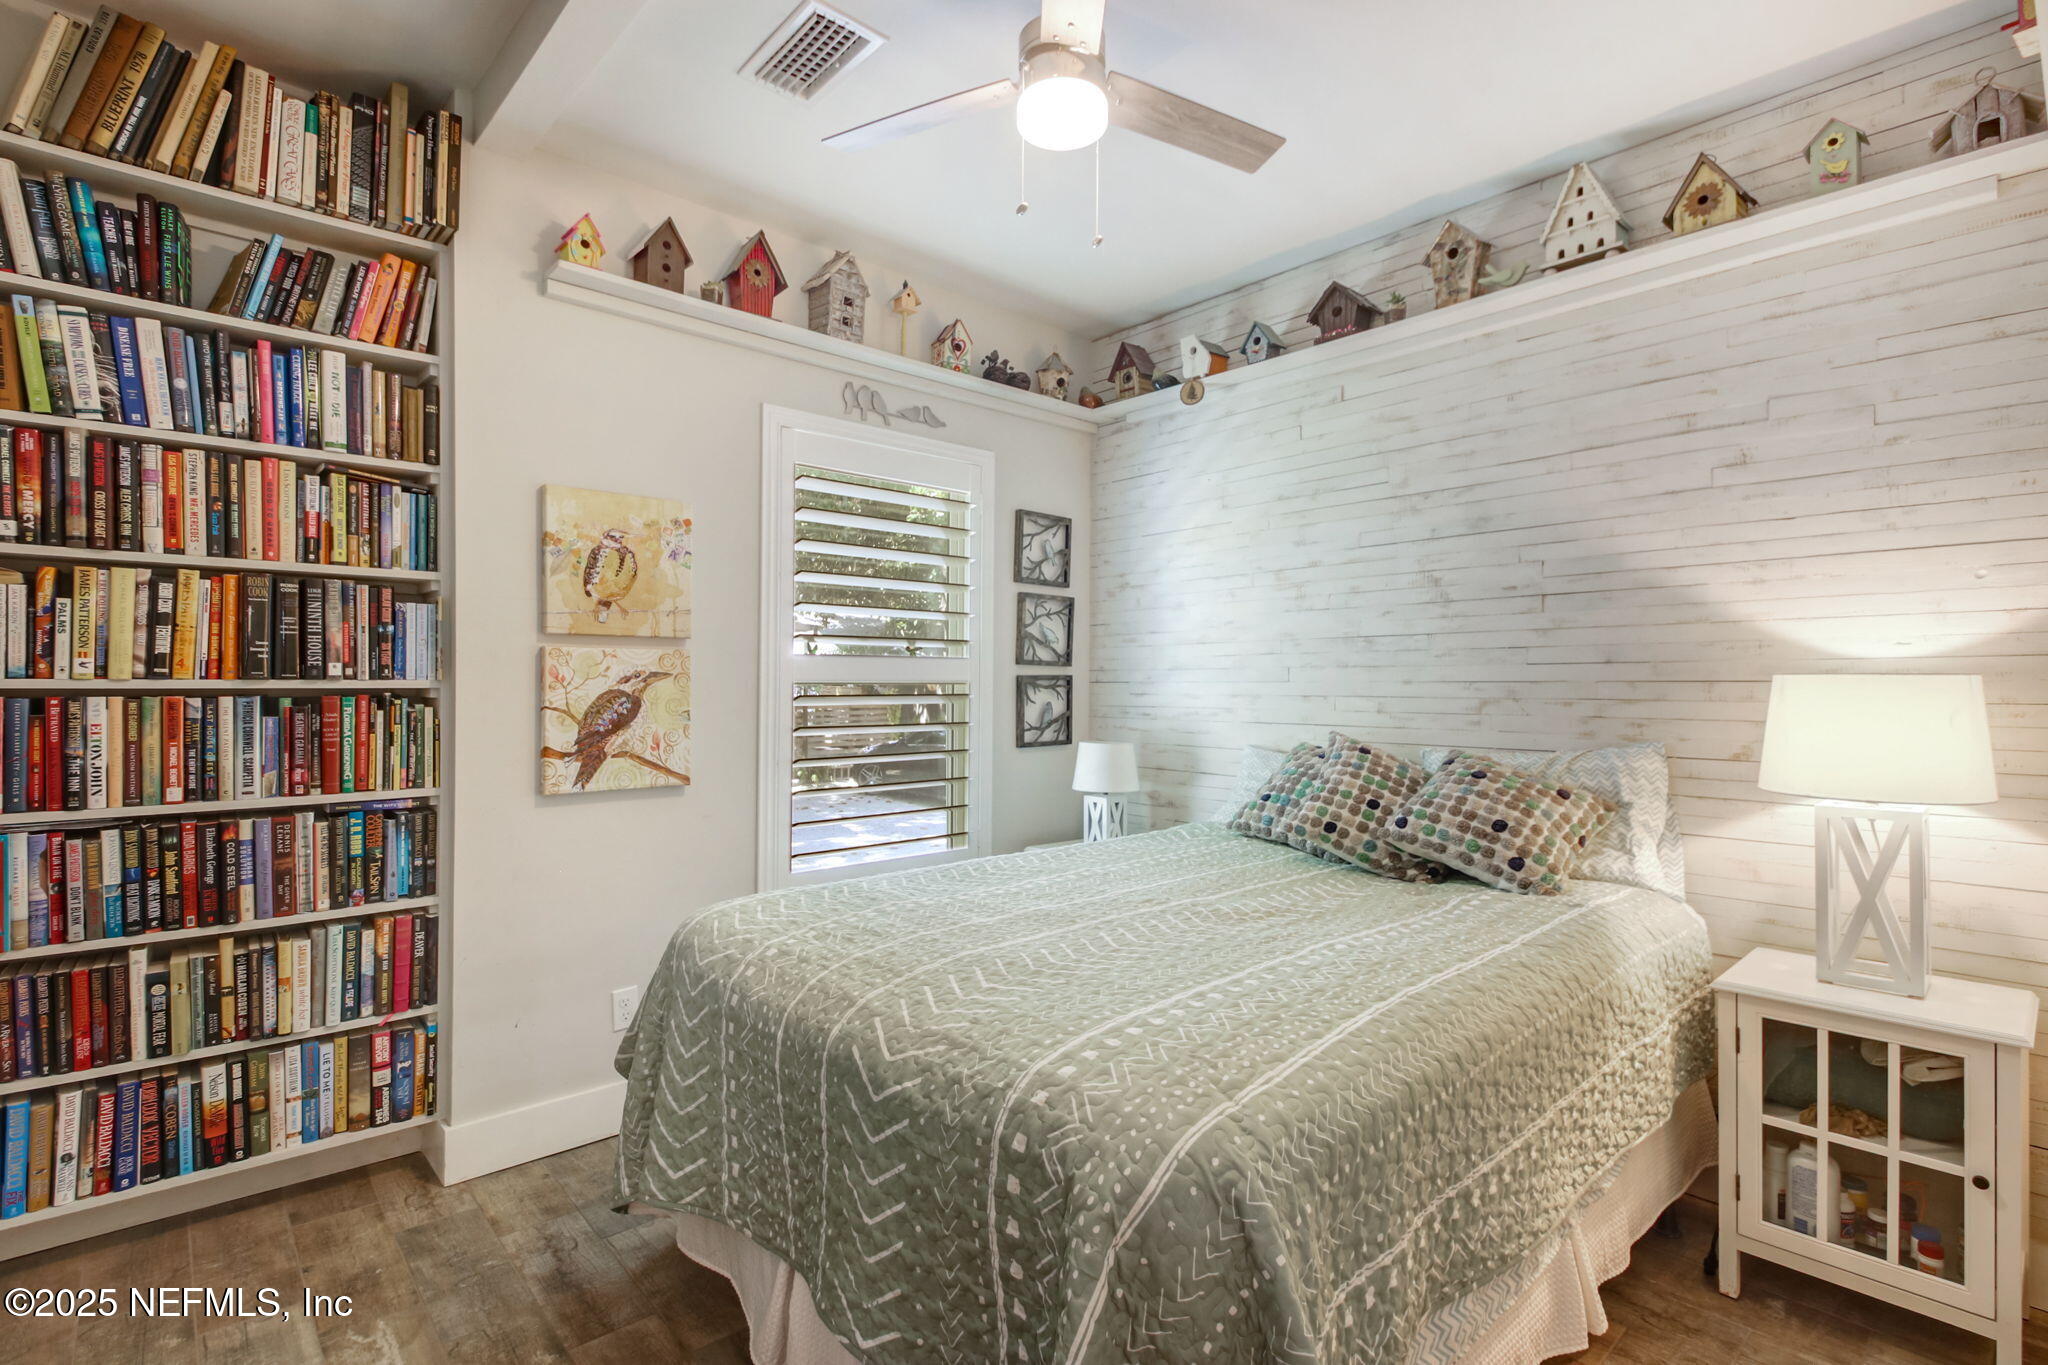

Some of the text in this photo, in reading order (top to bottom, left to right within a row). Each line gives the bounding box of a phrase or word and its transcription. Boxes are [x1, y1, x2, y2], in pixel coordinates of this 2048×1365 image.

[101, 51, 148, 133] BLUEPRINT 1978
[427, 115, 435, 138] Newport
[163, 233, 173, 289] FIRST LIE WINS
[287, 285, 302, 308] BRITNEY
[65, 319, 85, 350] SYMPTOMS
[116, 326, 136, 378] DISEASE FREE
[203, 355, 211, 367] THE
[204, 368, 213, 389] WATER
[291, 354, 301, 380] CURING
[331, 371, 341, 393] NOT
[331, 402, 341, 419] DIE
[68, 431, 81, 478] JAMES PATTERSON
[119, 445, 132, 461] JAMES
[168, 454, 177, 496] LISA SCOTTOLINE
[188, 452, 199, 497] STEPHEN KING
[22, 489, 35, 530] MERCY
[266, 481, 274, 505] GOOD
[337, 476, 345, 514] LISA SCOTTOLINE
[362, 483, 370, 530] LISA SCOTTOLINE
[94, 490, 106, 539] CROSS MY HEART
[189, 511, 200, 544] MERCEDES
[266, 507, 274, 518] TO
[79, 569, 92, 650] JAMES PATTERSON
[137, 604, 149, 625] WOODS
[157, 582, 173, 614] ROBIN COOK
[58, 602, 68, 635] PALMS
[307, 601, 322, 667] NINTH HOUSE
[154, 625, 172, 655] TERMINAL
[49, 706, 61, 743] BETRAYED
[67, 701, 82, 748] JAMES PATTERSON
[127, 702, 139, 716] MEG
[206, 706, 216, 723] LAST
[192, 722, 201, 742] STEVE
[206, 725, 216, 750] HOUSE
[242, 700, 255, 756] PATRICIA CORNWELL
[294, 712, 305, 766] HEATHER GRAHAM
[342, 706, 353, 781] FLORIDA GARDENING
[89, 722, 104, 798] ELTON JOHN
[188, 748, 197, 758] THE
[13, 777, 21, 797] GIRLS
[67, 757, 81, 793] THE INN
[129, 744, 137, 798] PHANTOM INSTINCT
[241, 757, 255, 788] SCARPETTA
[276, 825, 285, 855] LEHANE
[284, 824, 292, 853] DENNIS
[365, 815, 376, 849] COULTER
[373, 814, 384, 848] CATHERINE
[52, 837, 63, 880] BRAIN ON FIRE
[86, 843, 99, 866] SANDRA
[183, 831, 196, 875] LINDA BARNES
[204, 828, 217, 885] Elizabeth George
[226, 842, 237, 891] COLD STEEL
[240, 846, 248, 880] SOLUTION
[164, 851, 180, 895] John Sandford
[70, 886, 82, 927] DON'T BLINK
[345, 929, 356, 982] DAVID BALDACCI
[414, 931, 425, 959] DEAVER
[207, 969, 217, 996] Night Road
[237, 964, 248, 1017] HARLAN COBEN
[298, 989, 308, 1021] white hot
[152, 1010, 167, 1047] MORTAL FEAR
[375, 1036, 383, 1064] BEEVOR
[382, 1036, 391, 1062] ANTONY
[208, 1072, 226, 1100] Nelson
[250, 1059, 260, 1088] GRISHAM
[258, 1063, 267, 1079] JOHN
[322, 1053, 331, 1093] LIE TO ME
[119, 1085, 136, 1153] DAVID BALDACCI
[141, 1080, 159, 1125] ROBIN COOK
[375, 1108, 384, 1125] 1944
[382, 1086, 390, 1123] ARDENNES
[62, 1116, 76, 1154] BALDACCI
[97, 1095, 115, 1169] DAVID BALDACCI
[164, 1104, 178, 1141] COBEN
[7, 1106, 27, 1190] DAVID BALDACCI
[141, 1124, 160, 1166] VECTOR
